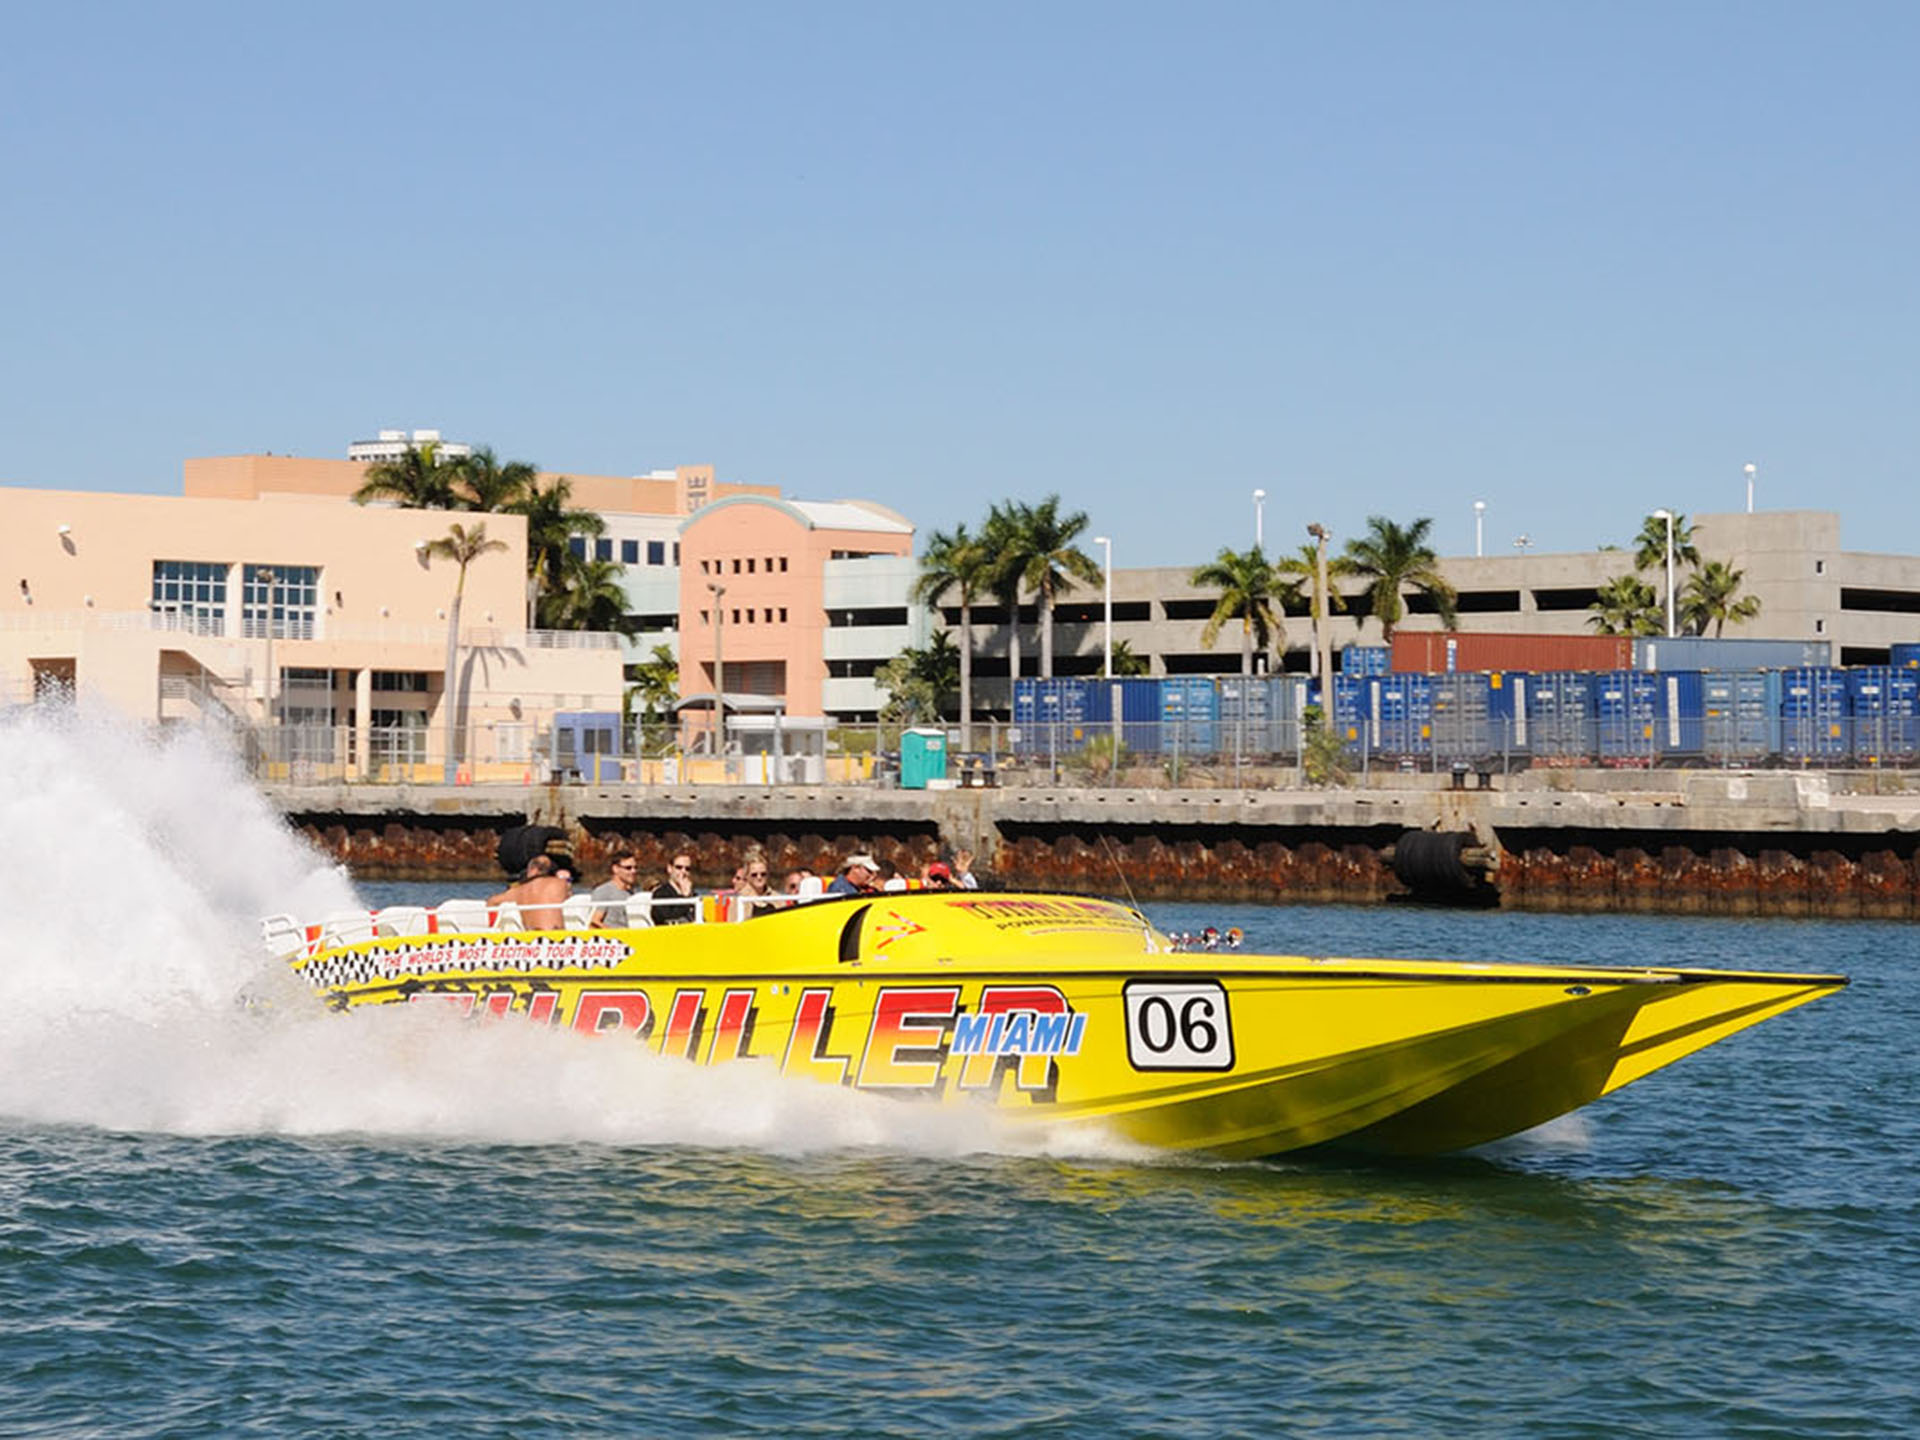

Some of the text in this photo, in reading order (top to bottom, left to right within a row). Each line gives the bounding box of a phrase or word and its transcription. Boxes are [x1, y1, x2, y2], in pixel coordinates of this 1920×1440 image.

[458, 947, 487, 960] MOST
[491, 945, 541, 959] EXCITING
[546, 945, 575, 958] TOUR
[953, 1011, 1087, 1056] MIAMI
[1137, 995, 1218, 1054] 06
